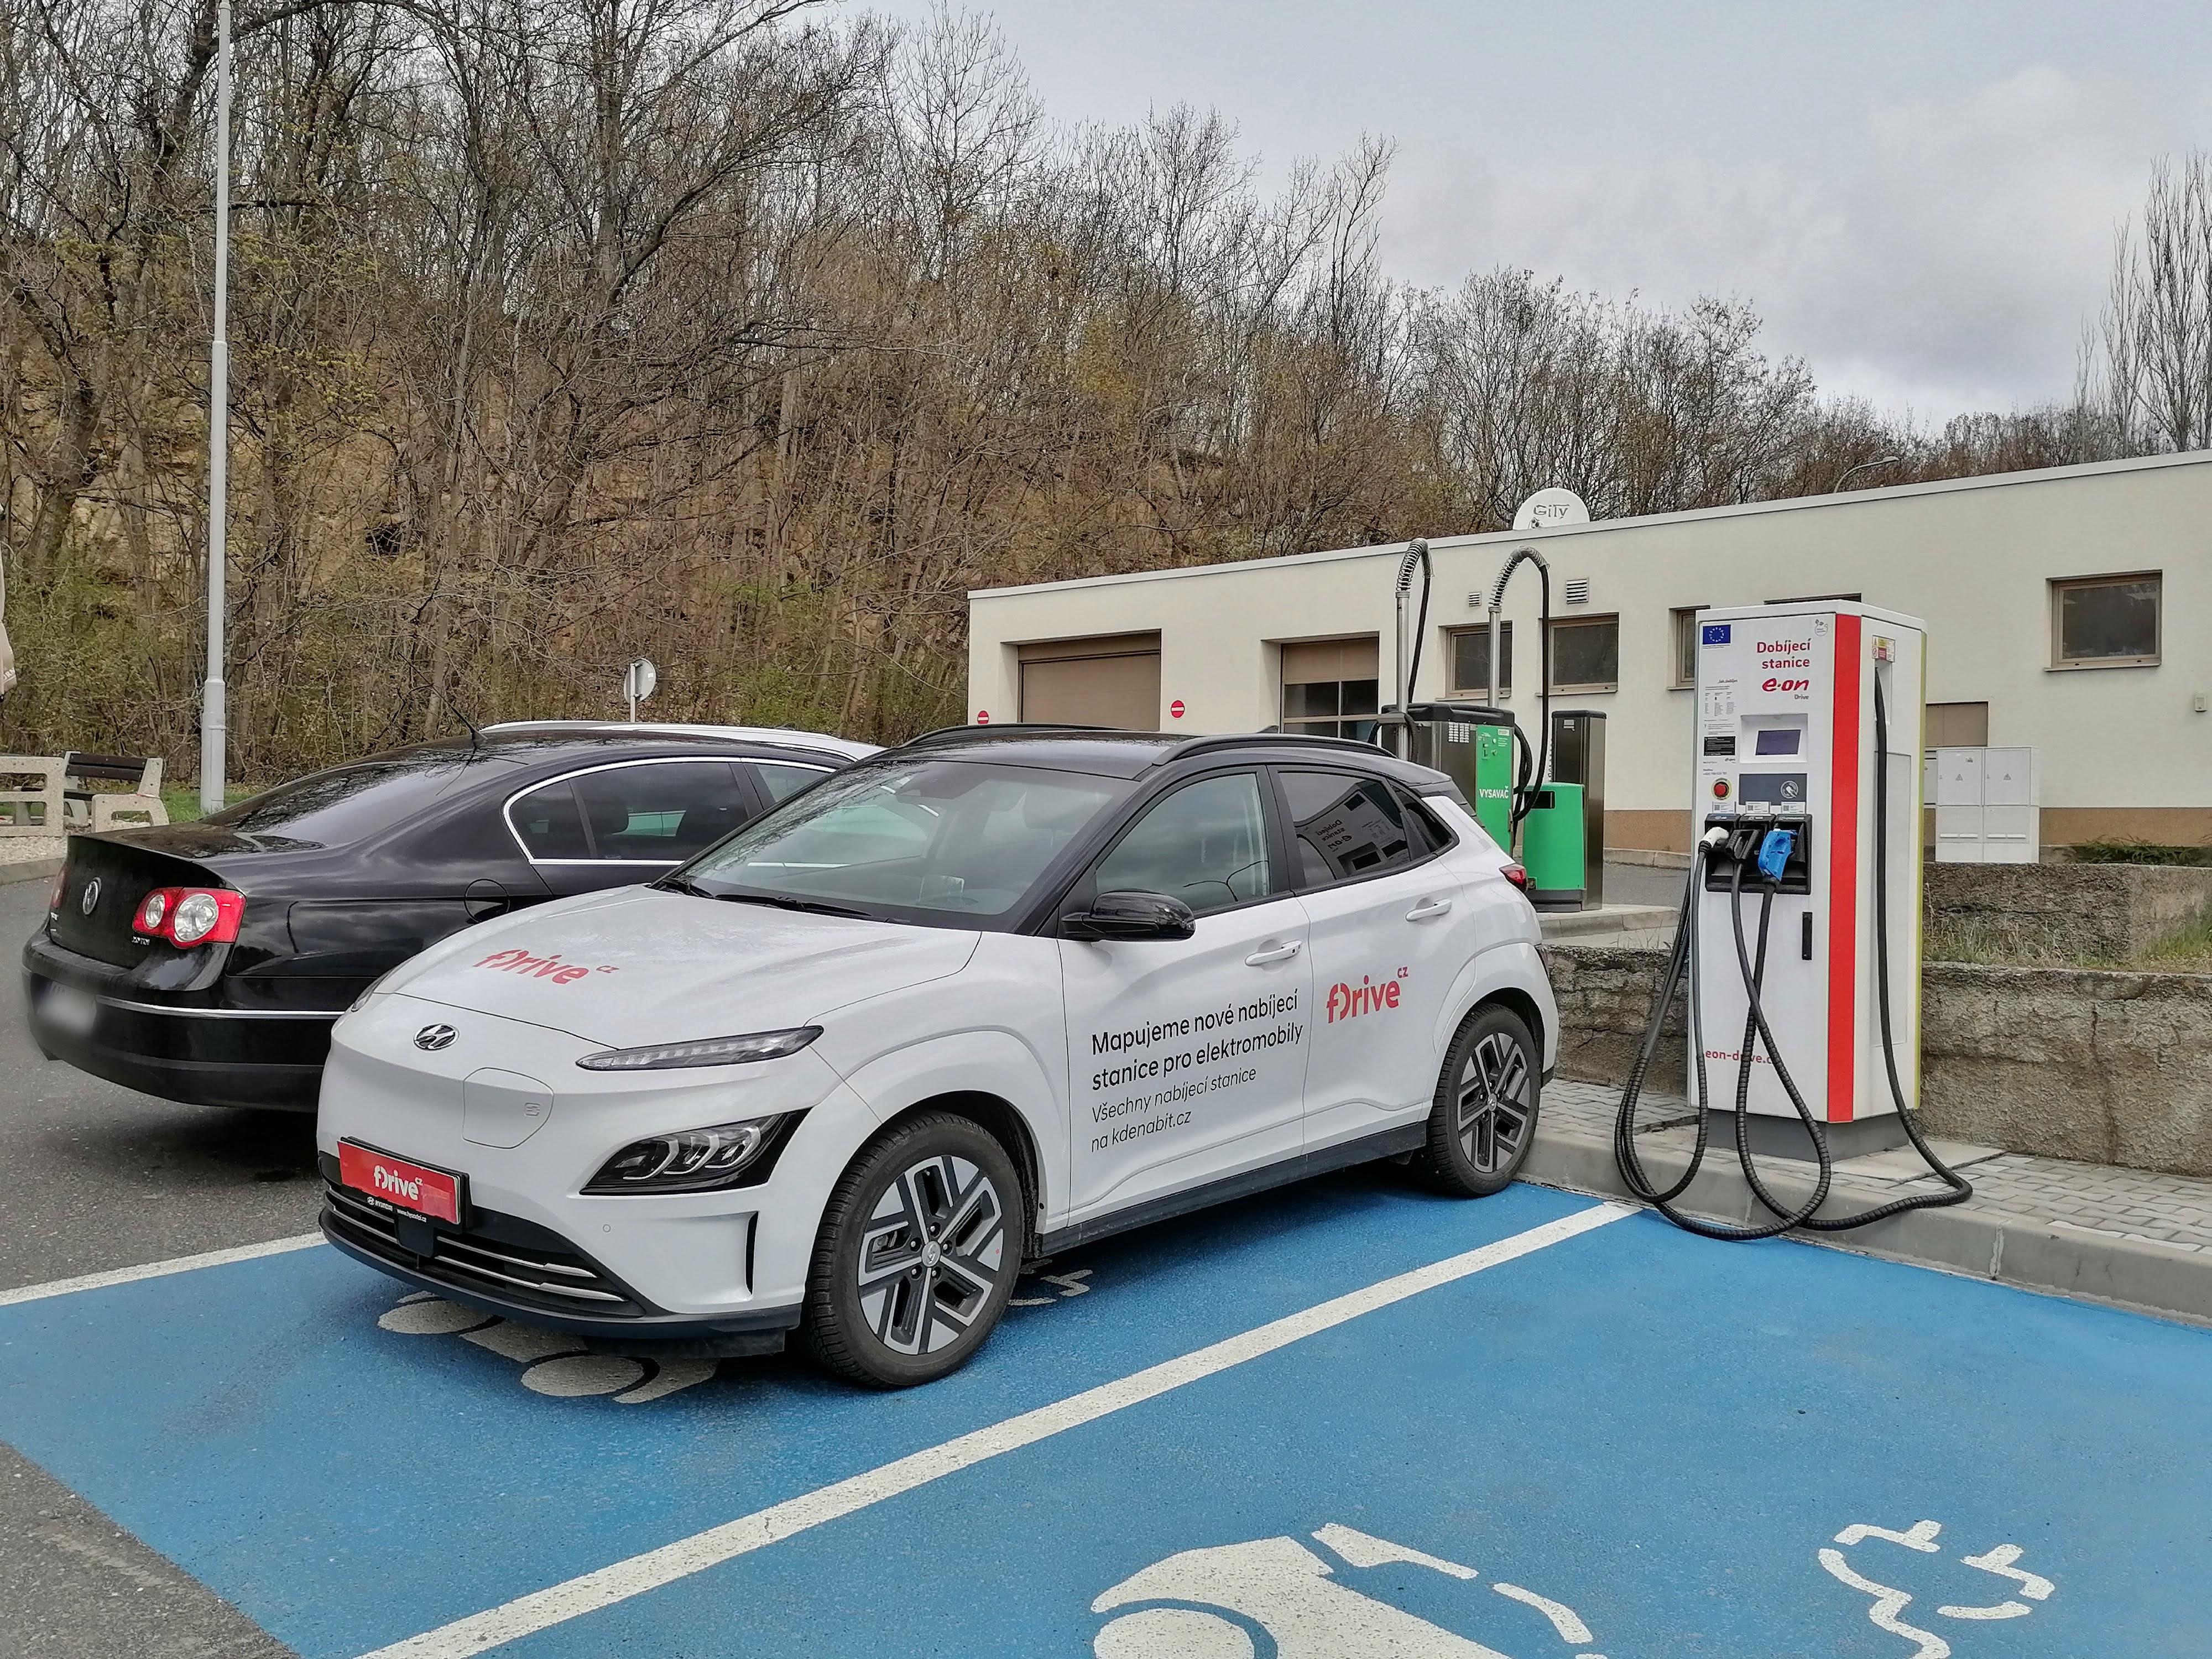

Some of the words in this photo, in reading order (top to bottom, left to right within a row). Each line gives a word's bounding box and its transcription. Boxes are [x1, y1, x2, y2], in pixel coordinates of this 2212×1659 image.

[1757, 638, 1811, 655] Dobíjecí
[1762, 656, 1810, 669] stanice
[1479, 785, 1509, 799] VYSAVAČ
[1092, 1019, 1190, 1055] Mapujeme
[1195, 1003, 1234, 1032] nové
[1239, 988, 1298, 1022] nabíjecí
[1327, 975, 1400, 1024] fDrive
[1093, 1058, 1159, 1091] stanice
[1164, 1053, 1191, 1078] pro
[1197, 1022, 1303, 1065] elektromobily
[1092, 1097, 1151, 1123] Všechny
[1155, 1076, 1208, 1102] nabíjecí
[1211, 1067, 1256, 1091] stanice
[1092, 1135, 1108, 1152] na
[1112, 1111, 1192, 1145] kdenabit.cz
